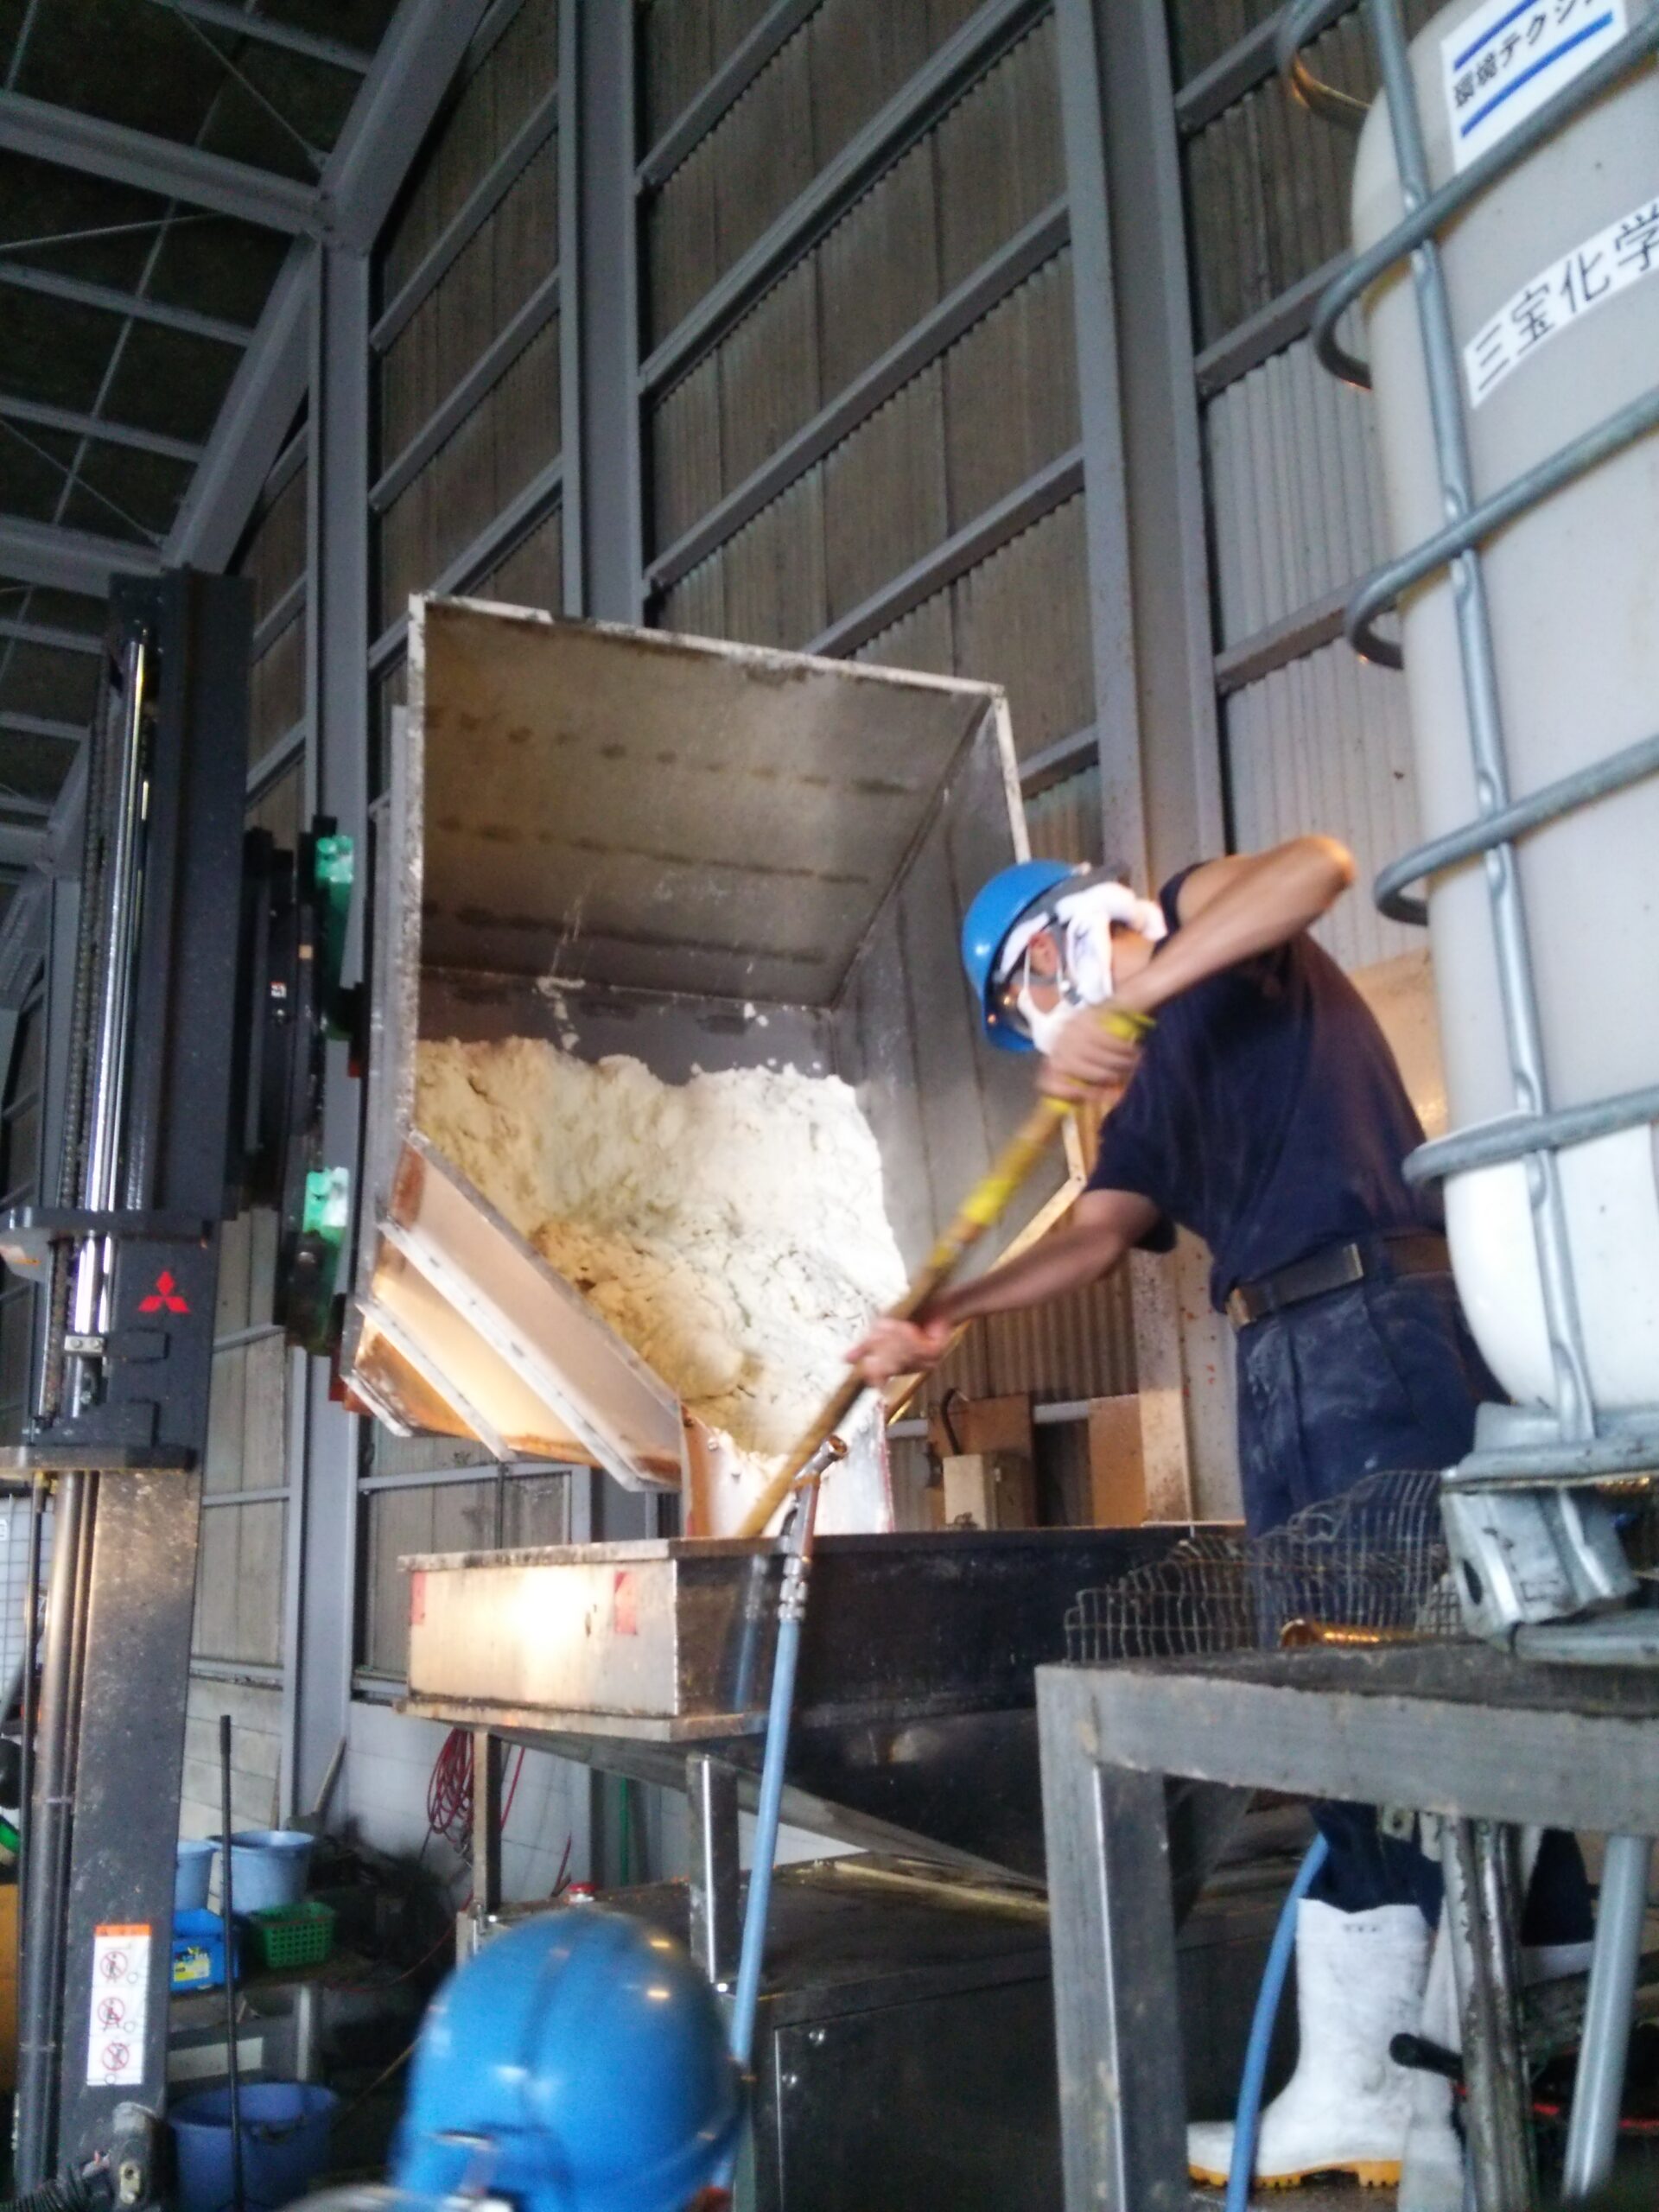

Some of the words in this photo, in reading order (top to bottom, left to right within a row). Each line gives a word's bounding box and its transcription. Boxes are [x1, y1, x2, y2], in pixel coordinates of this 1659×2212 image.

[1454, 0, 1592, 108] 環境テクシ
[1476, 203, 1659, 391] 三宝化学
